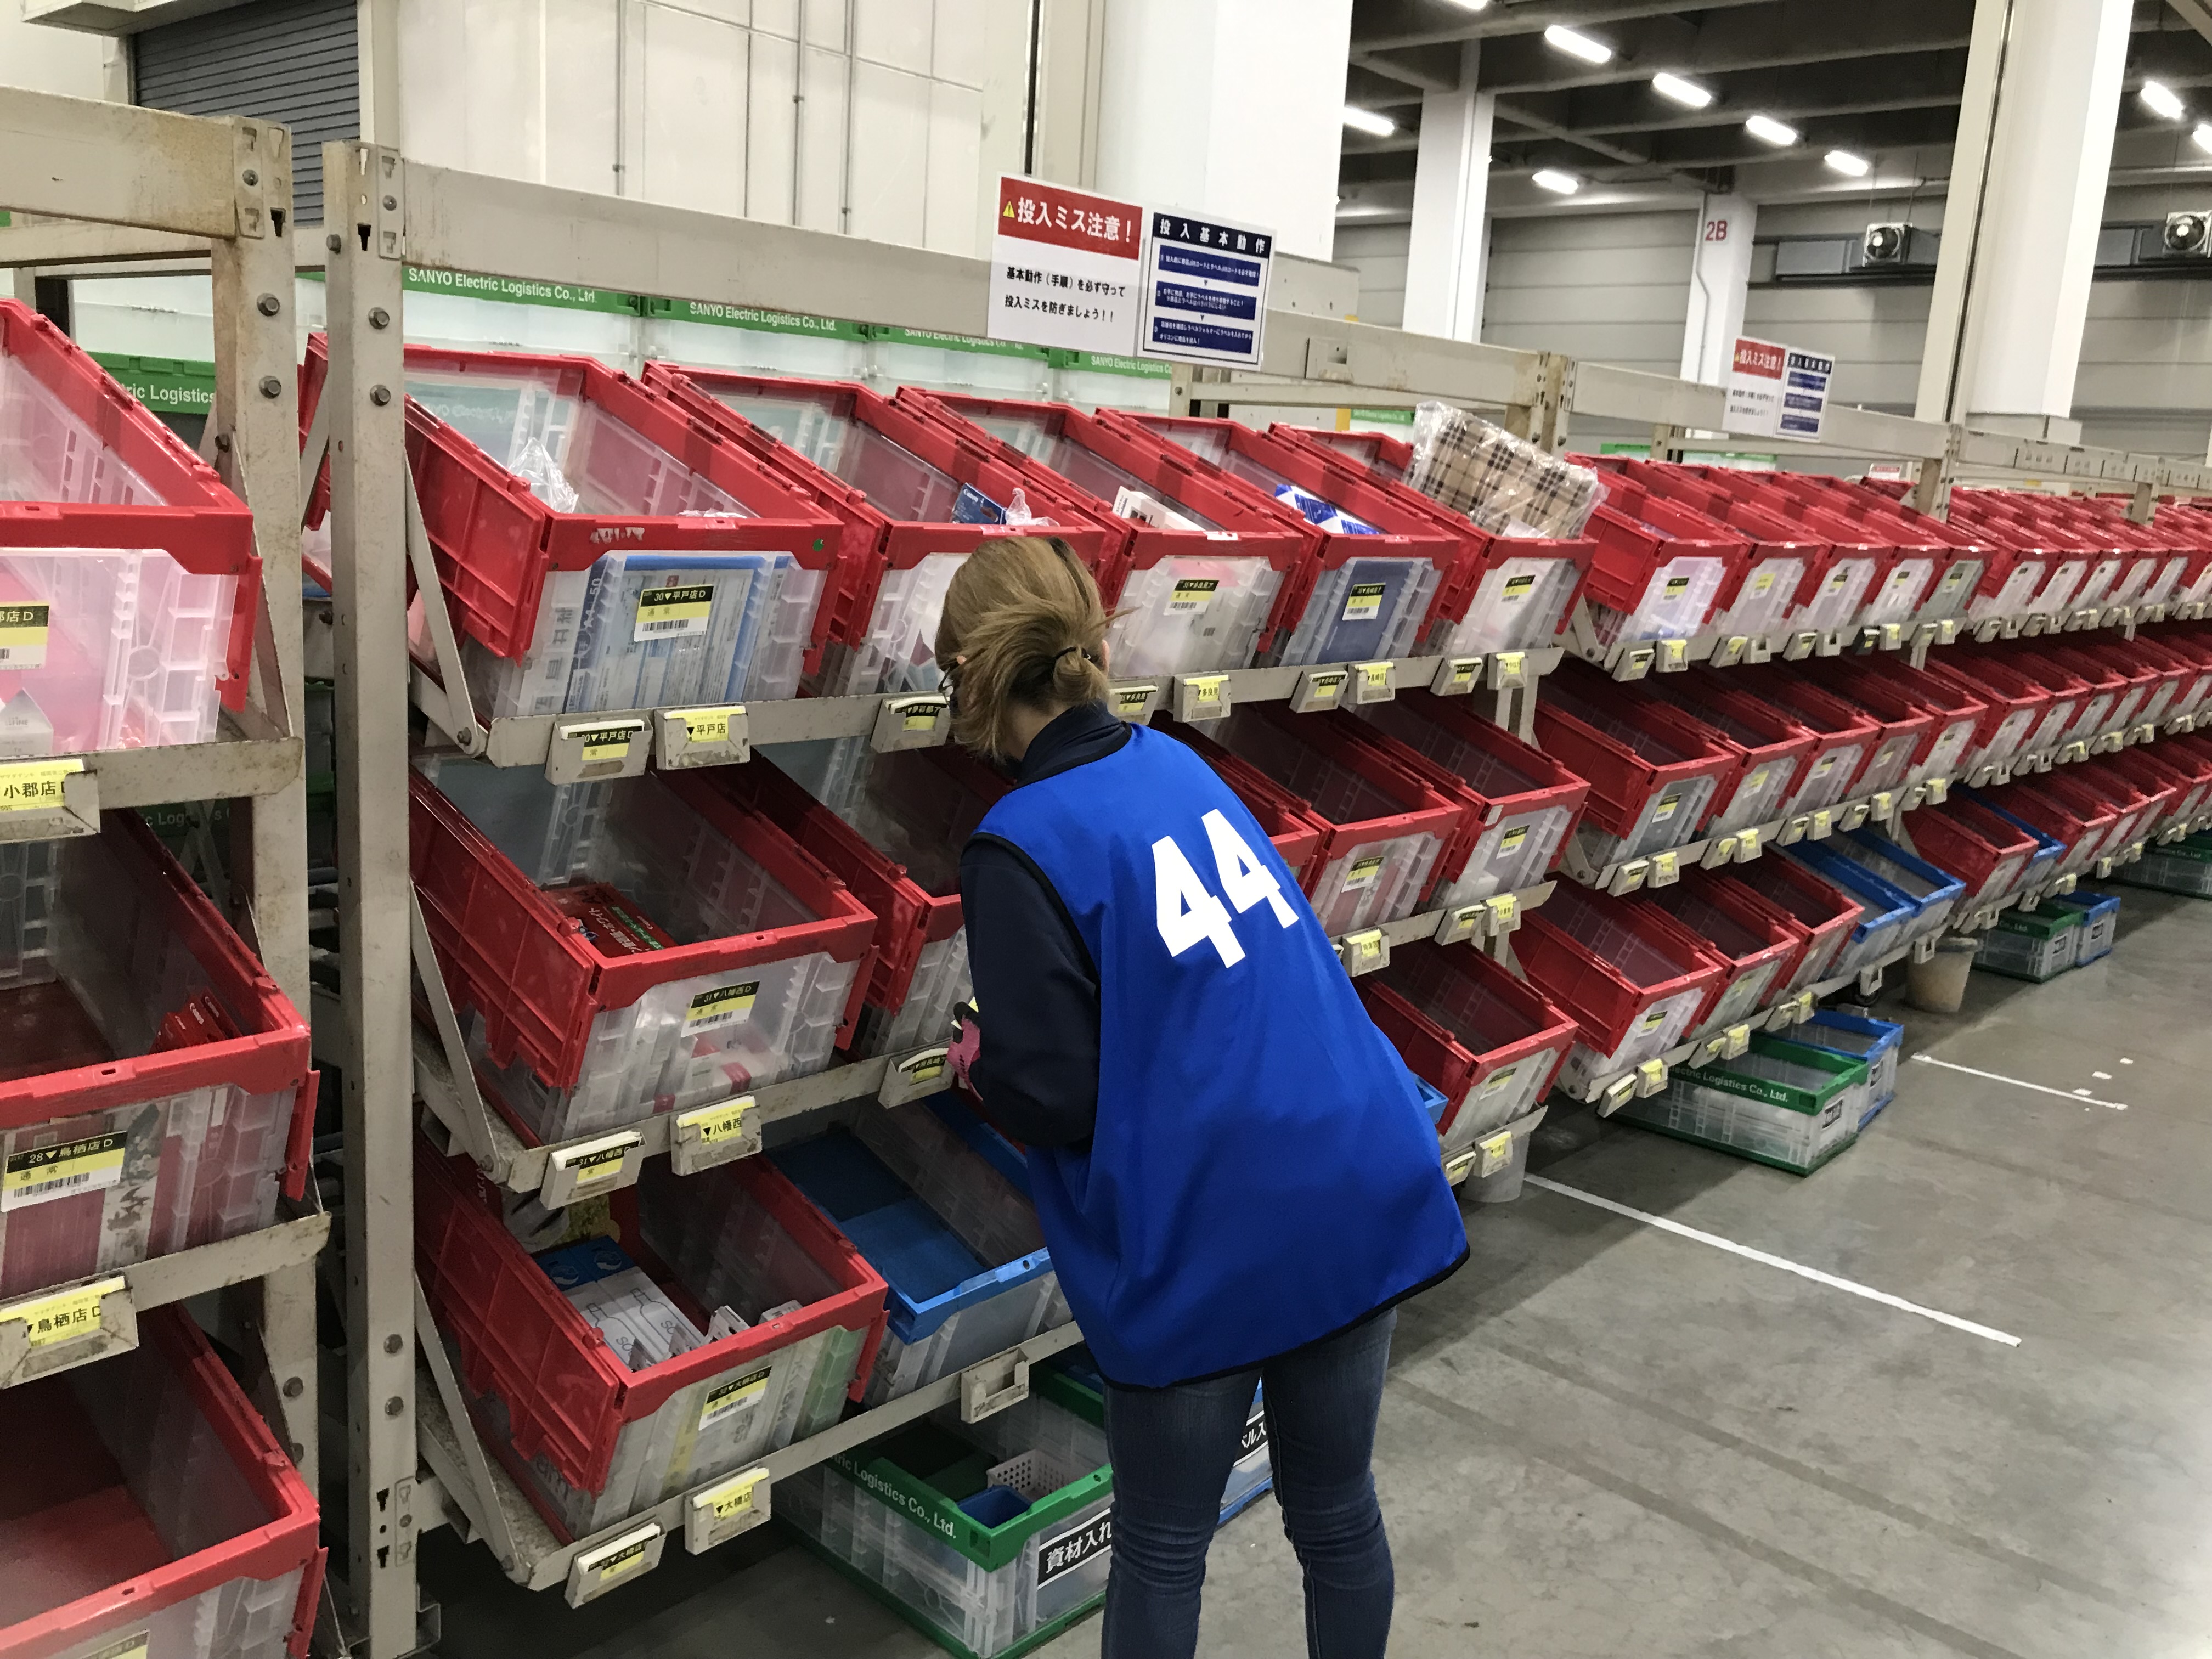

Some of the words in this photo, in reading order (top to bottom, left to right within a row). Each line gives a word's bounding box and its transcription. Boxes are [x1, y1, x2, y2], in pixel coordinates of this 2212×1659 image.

[1017, 196, 1131, 243] 投入ミス注意！
[1705, 220, 1728, 241] 2B
[409, 267, 453, 285] SANYO
[455, 273, 499, 291] Electric
[501, 280, 552, 298] Logistics
[554, 285, 575, 303] Co.,
[578, 289, 597, 303] Ltd.
[1006, 266, 1126, 297] 基本動作（手順）を必ず守って
[690, 302, 724, 317] SANYO
[726, 306, 759, 321] Electric
[761, 311, 800, 327] Logistics
[803, 316, 820, 331] Co.,
[821, 319, 837, 331] Ltd.
[1005, 295, 1114, 323] 投入ミスを防ぎましょう！！
[1091, 356, 1113, 368] SANYO
[1114, 358, 1137, 370] Electric
[1137, 361, 1164, 374] Logistics
[654, 592, 664, 601] 30
[696, 723, 726, 736] 平戸店
[1152, 809, 1300, 969] 44
[1703, 1071, 1747, 1091] Logistics
[1770, 1089, 1788, 1102] Ltd.
[713, 1118, 742, 1135] 八幡西
[29, 1153, 44, 1164] 28
[59, 1139, 114, 1158] 鳥栖店D
[854, 1461, 906, 1505] Logistics
[908, 1497, 930, 1523] Co.,
[934, 1512, 956, 1538] Ltd.
[1046, 1522, 1111, 1573] 資材入れ
